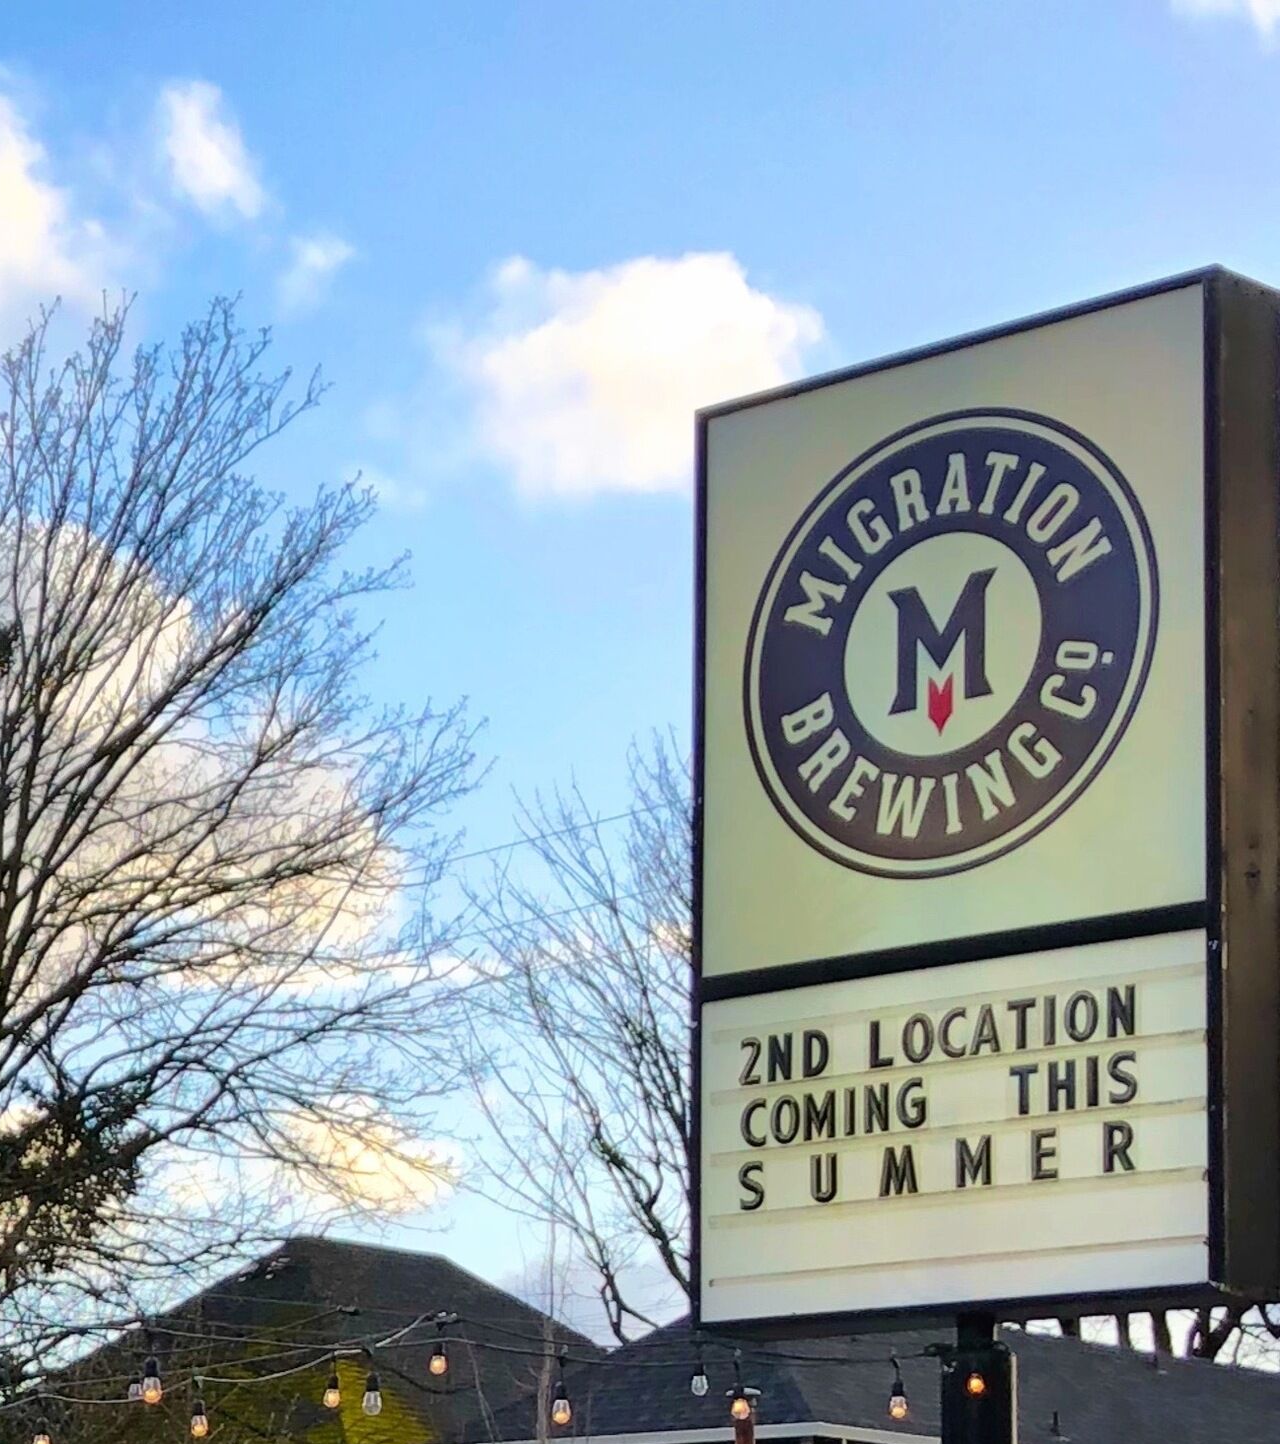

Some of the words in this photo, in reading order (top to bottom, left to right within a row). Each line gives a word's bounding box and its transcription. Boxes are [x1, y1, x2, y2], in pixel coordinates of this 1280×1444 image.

[784, 452, 1113, 636] MIGRATION
[887, 568, 997, 717] M
[780, 691, 1064, 839] BREWING
[739, 1028, 830, 1086] 2ND
[868, 984, 1137, 1070] LOCATION
[740, 1076, 928, 1148] COMING
[1008, 1050, 1139, 1116] THIS
[739, 1120, 1136, 1211] SUMMER
